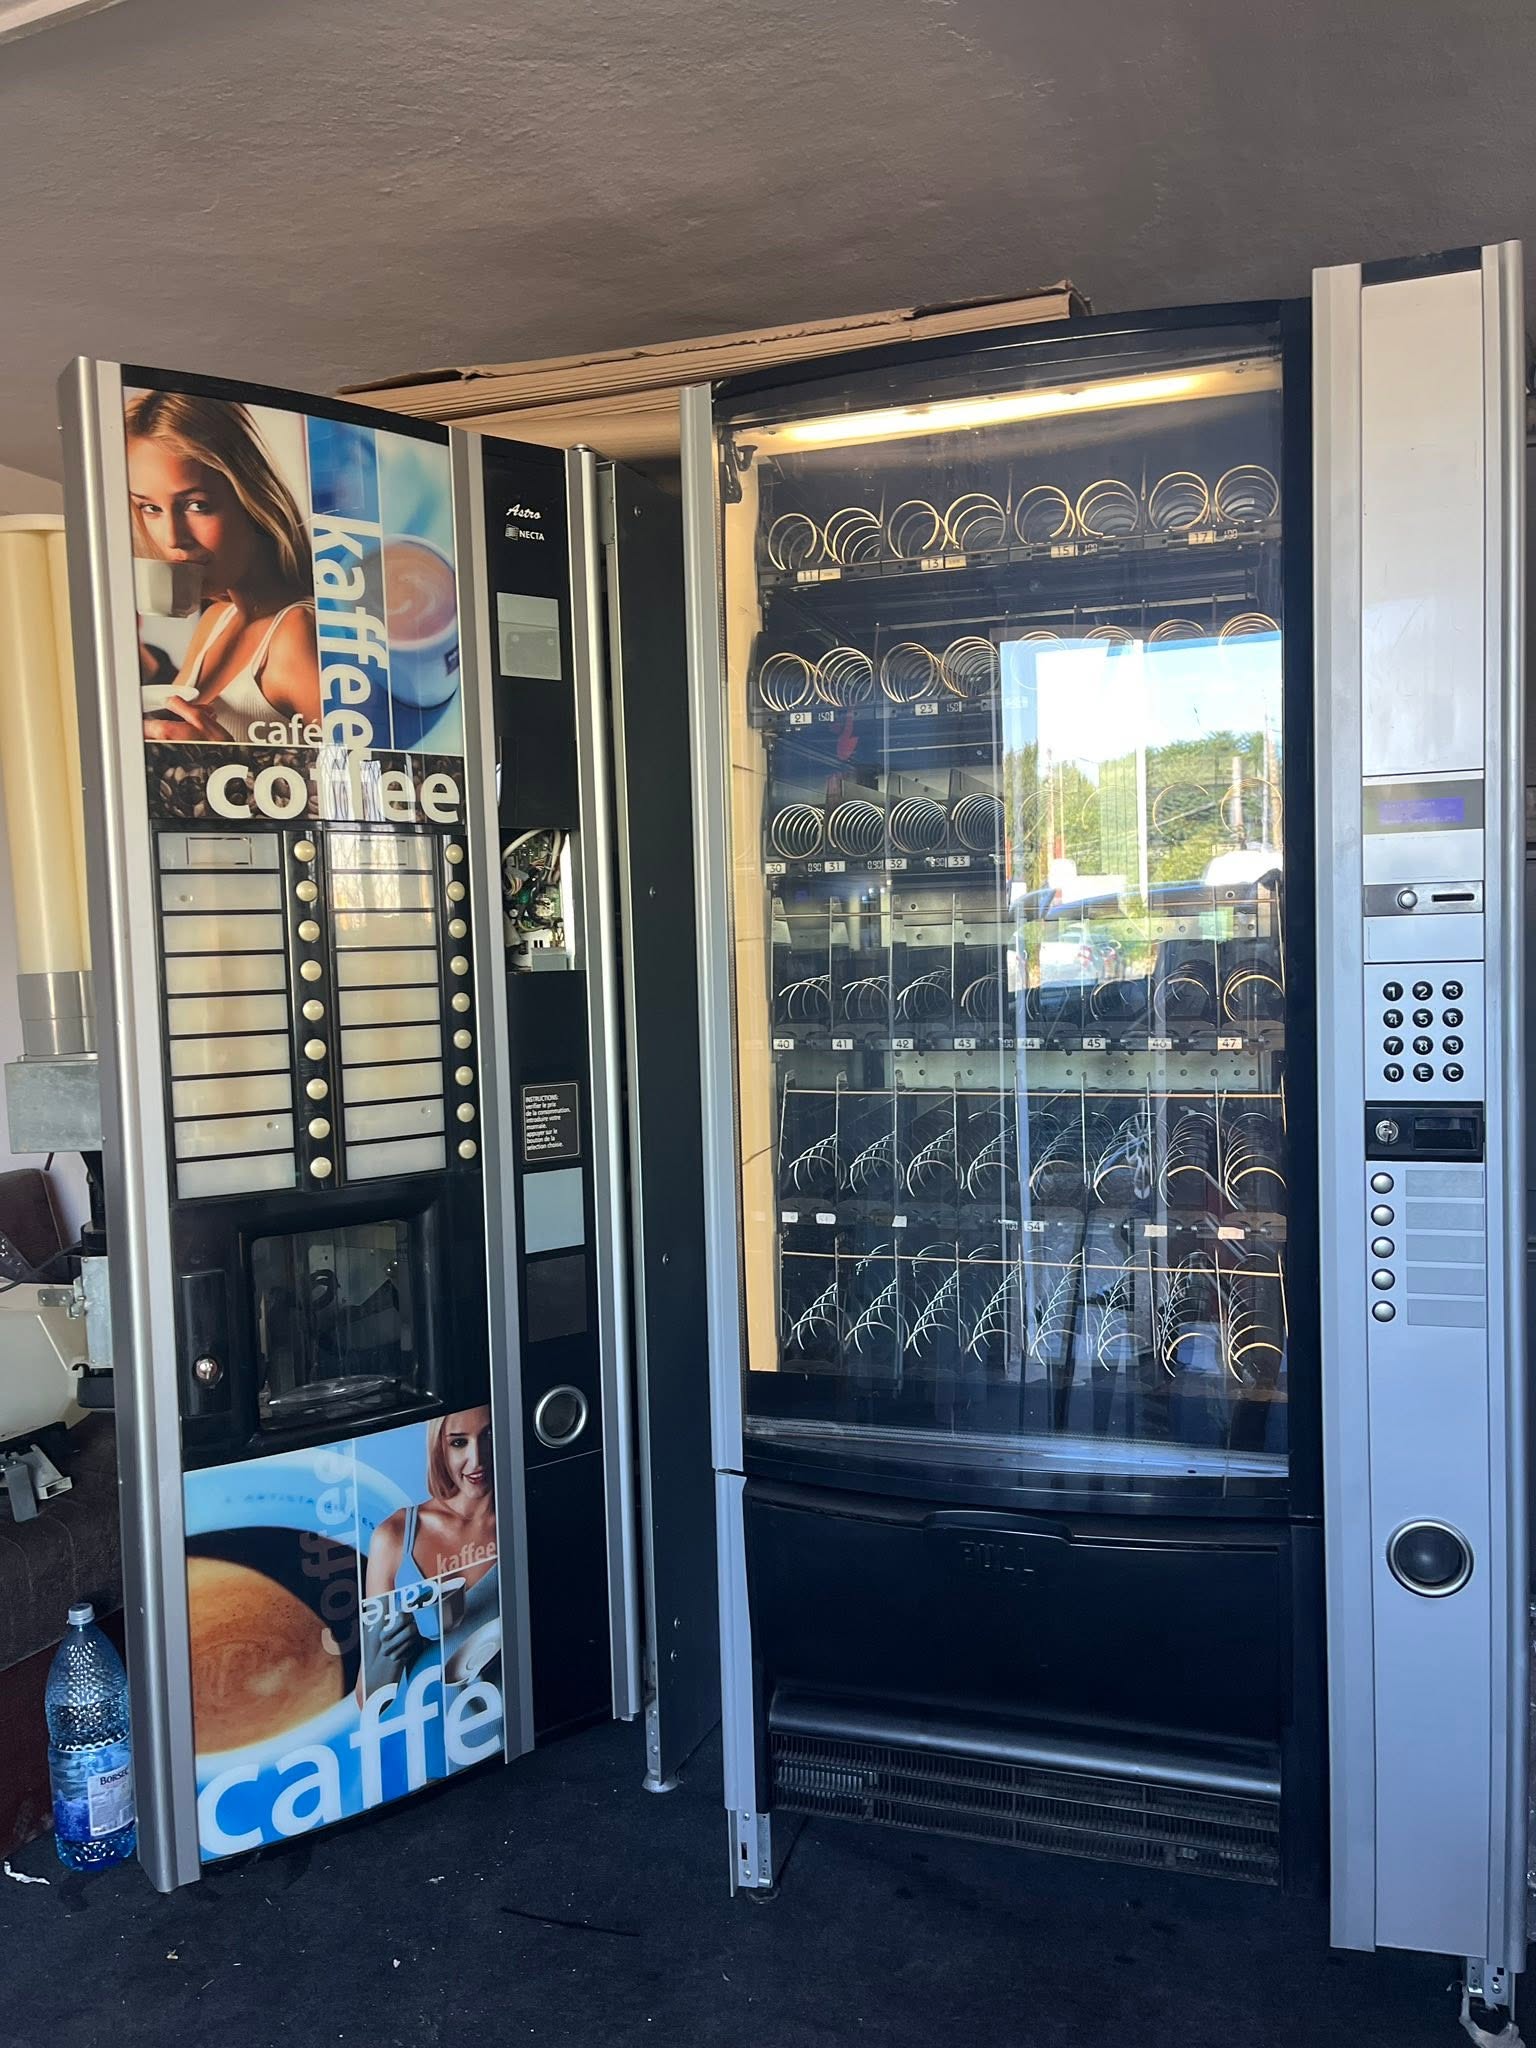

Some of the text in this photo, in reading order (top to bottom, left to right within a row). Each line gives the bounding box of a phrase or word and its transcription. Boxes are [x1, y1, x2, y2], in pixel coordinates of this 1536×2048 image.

[506, 503, 541, 519] Astro
[519, 530, 544, 540] NECTA
[311, 513, 388, 750] kaffee
[919, 704, 934, 714] 23
[247, 713, 323, 746] café
[206, 750, 460, 824] coffee
[889, 859, 902, 869] 32
[952, 856, 966, 866] 33
[1418, 986, 1428, 998] 2
[1447, 985, 1459, 997] 3
[1388, 1012, 1458, 1025] 4 5 6
[776, 1039, 790, 1049] 40
[895, 1039, 910, 1049] 42
[957, 1038, 972, 1048] 43
[1020, 1039, 1035, 1049] 44
[1087, 1038, 1101, 1049] 45
[1221, 1038, 1237, 1048] 47
[1389, 1040, 1459, 1052] 7 8 9
[1390, 1067, 1460, 1079] 0 E C
[1026, 1221, 1041, 1231] 54
[301, 1447, 361, 1656] coffee
[436, 1541, 496, 1576] kaffee
[361, 1579, 441, 1632] café
